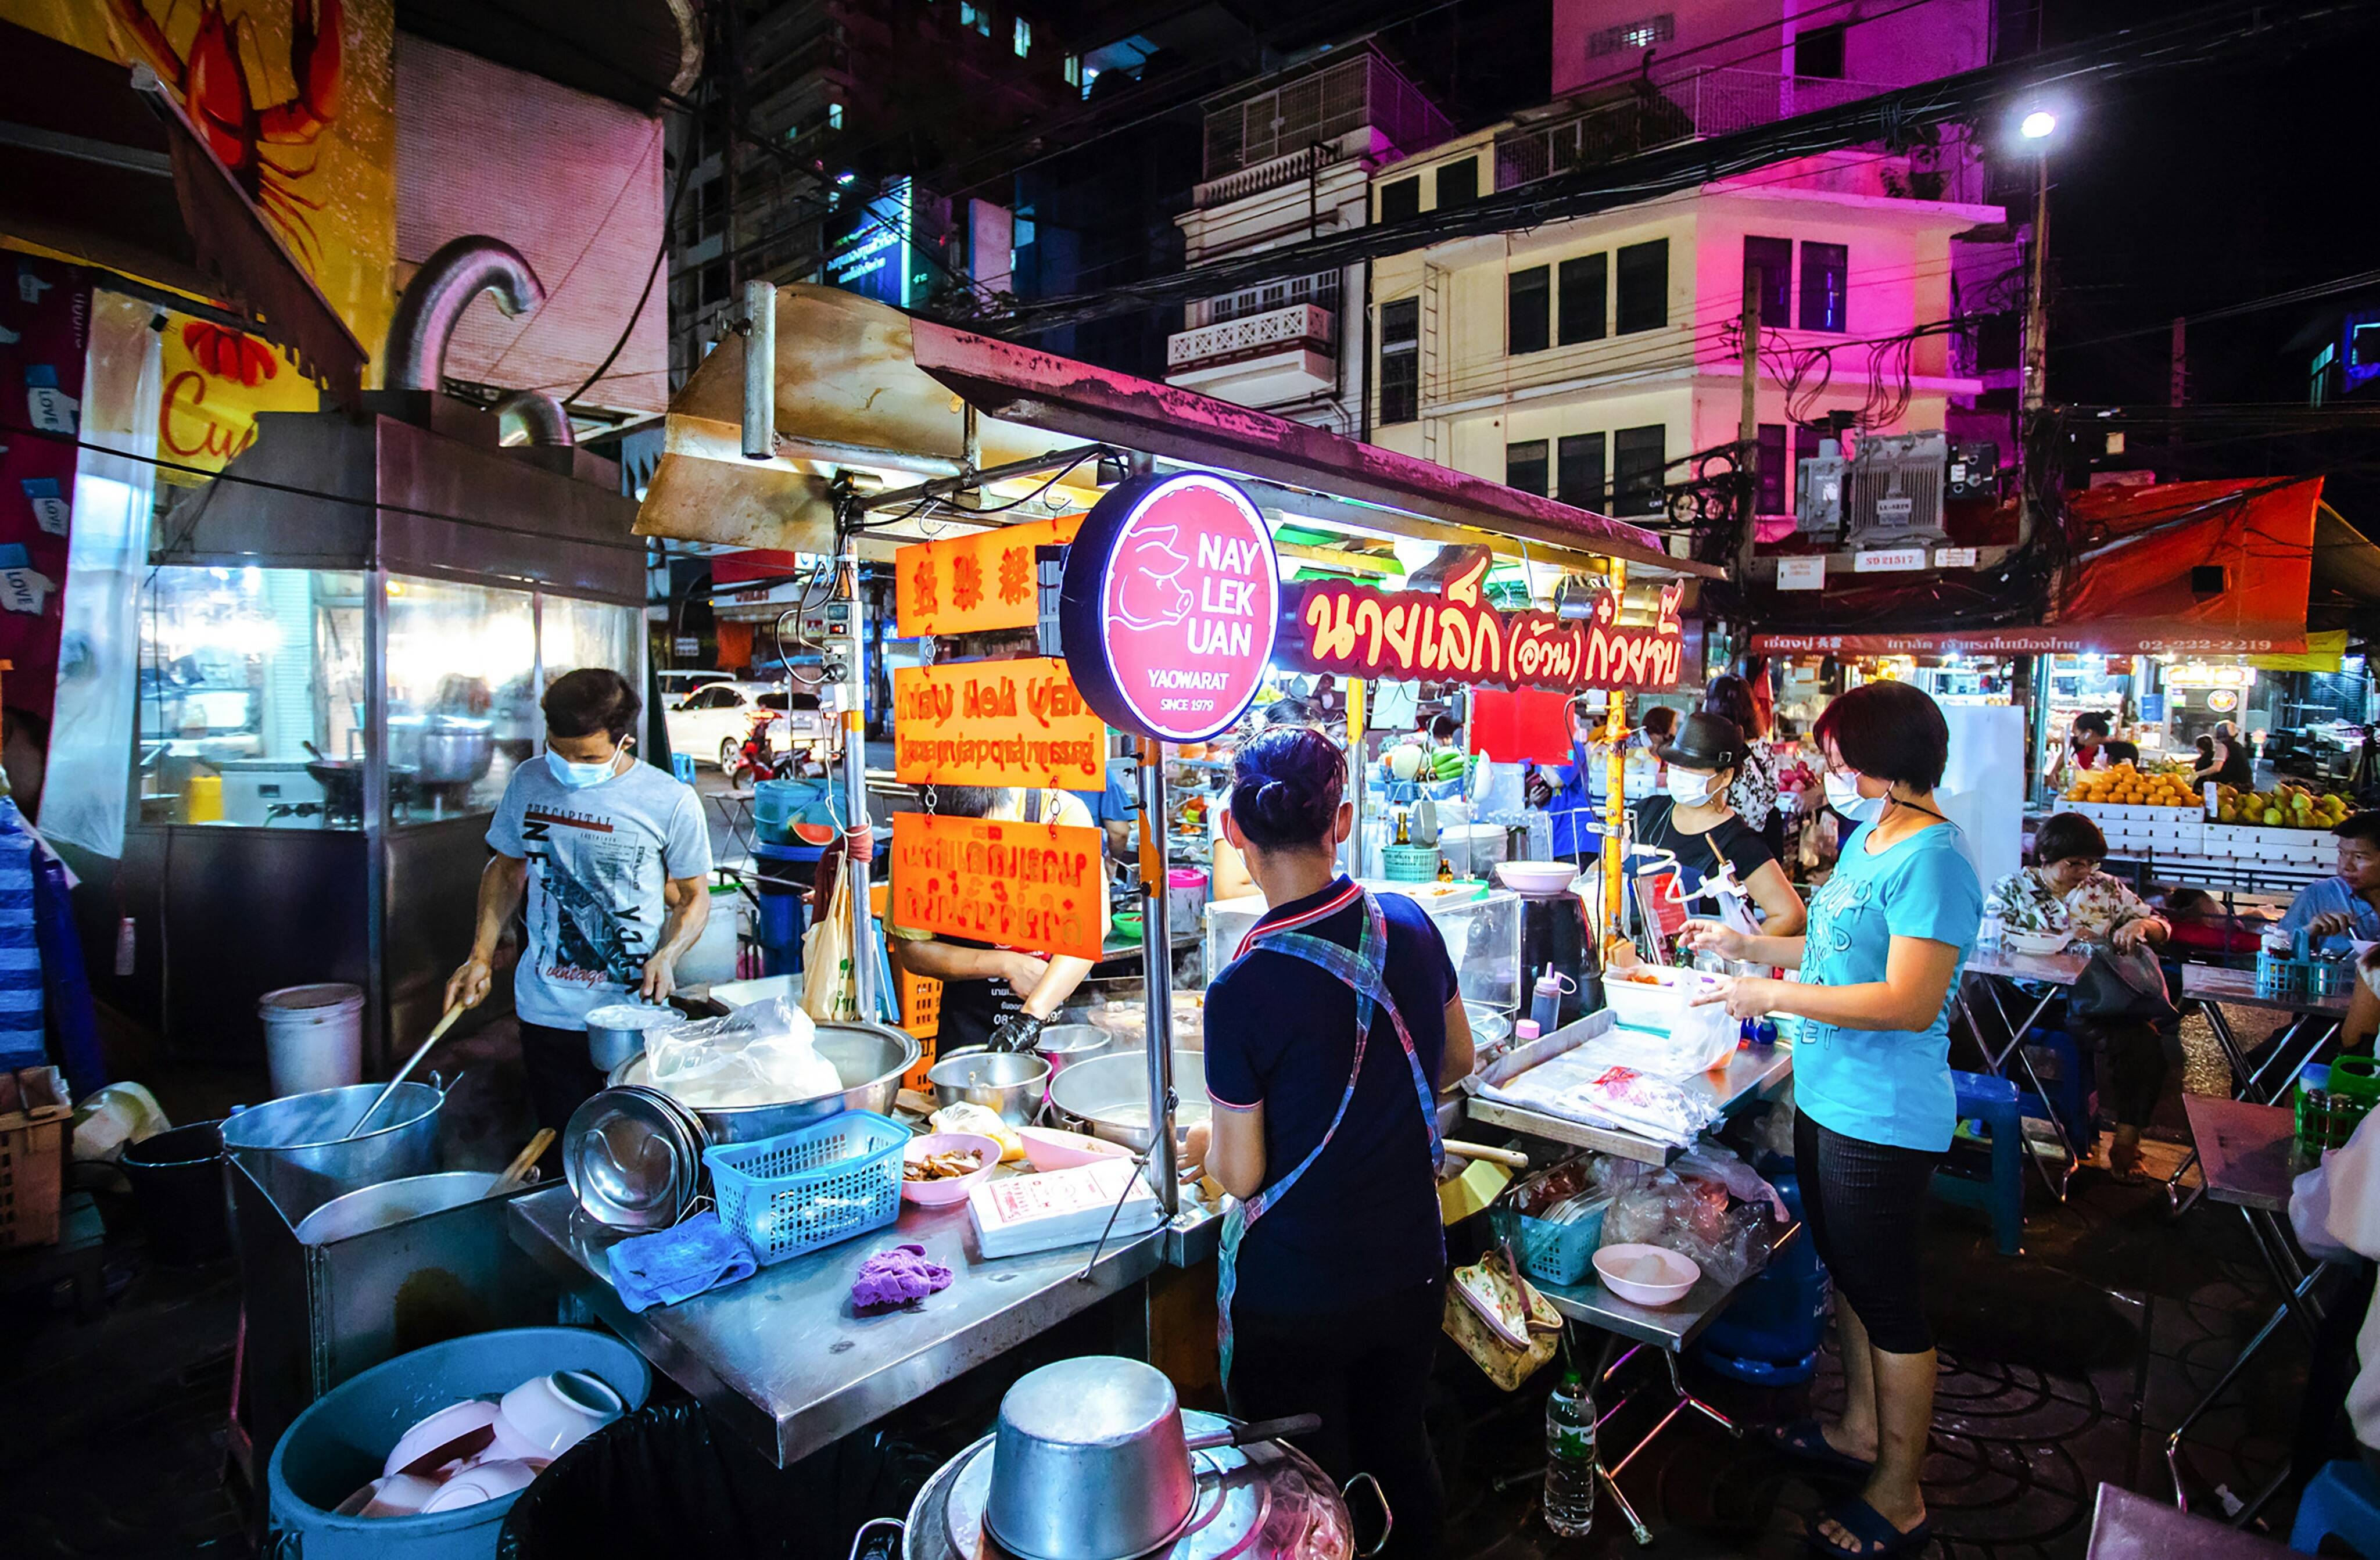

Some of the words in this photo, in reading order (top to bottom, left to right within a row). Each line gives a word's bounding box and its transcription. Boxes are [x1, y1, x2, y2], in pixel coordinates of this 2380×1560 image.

[38, 390, 59, 424] LOVE
[45, 500, 60, 527] LOVE
[1198, 532, 1260, 574] NAY
[6, 572, 34, 605] LOVE
[1202, 579, 1257, 616] LEK
[1305, 556, 1501, 673] นายเล็ก
[1508, 619, 1582, 684] (อ้วน)
[1186, 621, 1252, 658] UAN
[2138, 640, 2272, 651] 02-222-2219
[1148, 668, 1231, 691] YAOWARAT
[1160, 698, 1188, 712] SINCE
[1189, 698, 1214, 712] 1979
[545, 962, 608, 989] vintage
